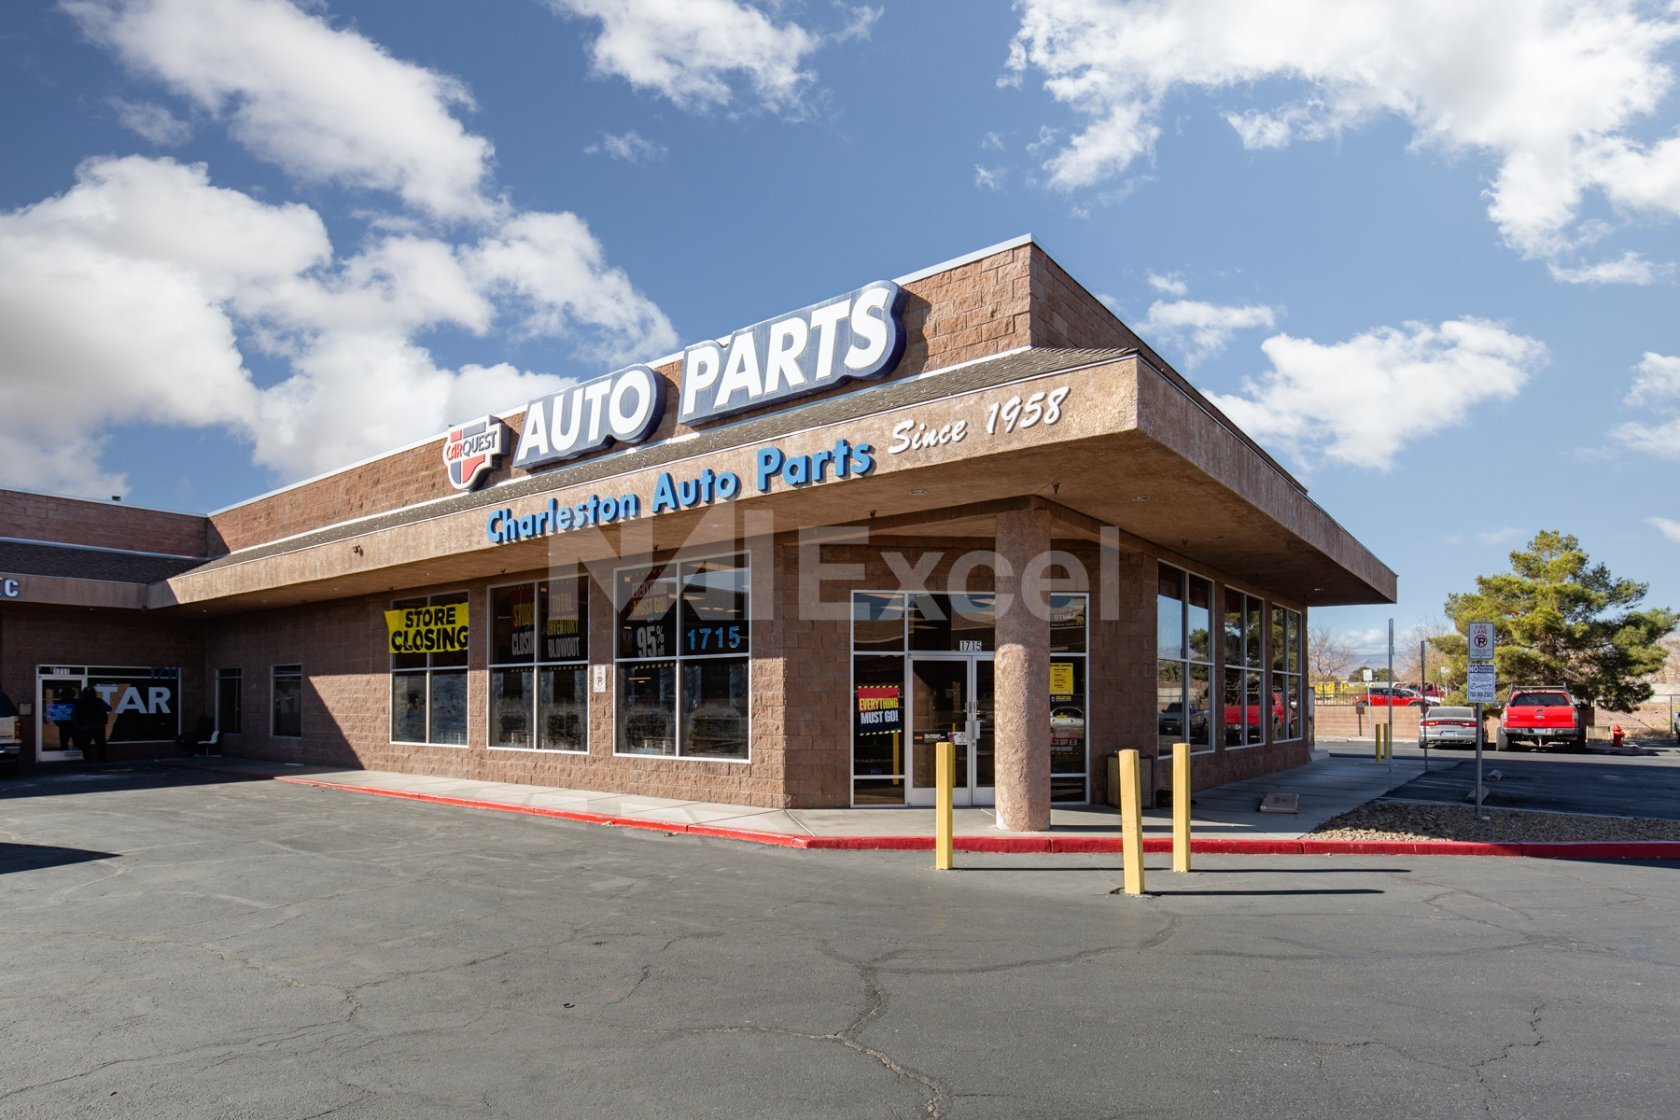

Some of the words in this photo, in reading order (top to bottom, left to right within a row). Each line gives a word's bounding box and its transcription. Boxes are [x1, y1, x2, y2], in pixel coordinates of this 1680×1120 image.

[515, 369, 652, 462] AUTO
[682, 286, 891, 417] PARTS
[446, 430, 498, 461] CARQUEST
[486, 492, 638, 543] Charleston
[651, 468, 739, 514] Auto
[756, 438, 875, 492] Parts
[887, 418, 968, 455] Since
[986, 385, 1071, 435] 1958
[405, 606, 456, 628] STORE
[391, 625, 469, 652] CLOSING
[688, 626, 740, 651] 1715
[961, 640, 982, 651] 1715
[1468, 665, 1479, 673] NO
[858, 697, 899, 710] EVERYTHING
[860, 710, 884, 725] MUST
[884, 709, 899, 723] GO!
